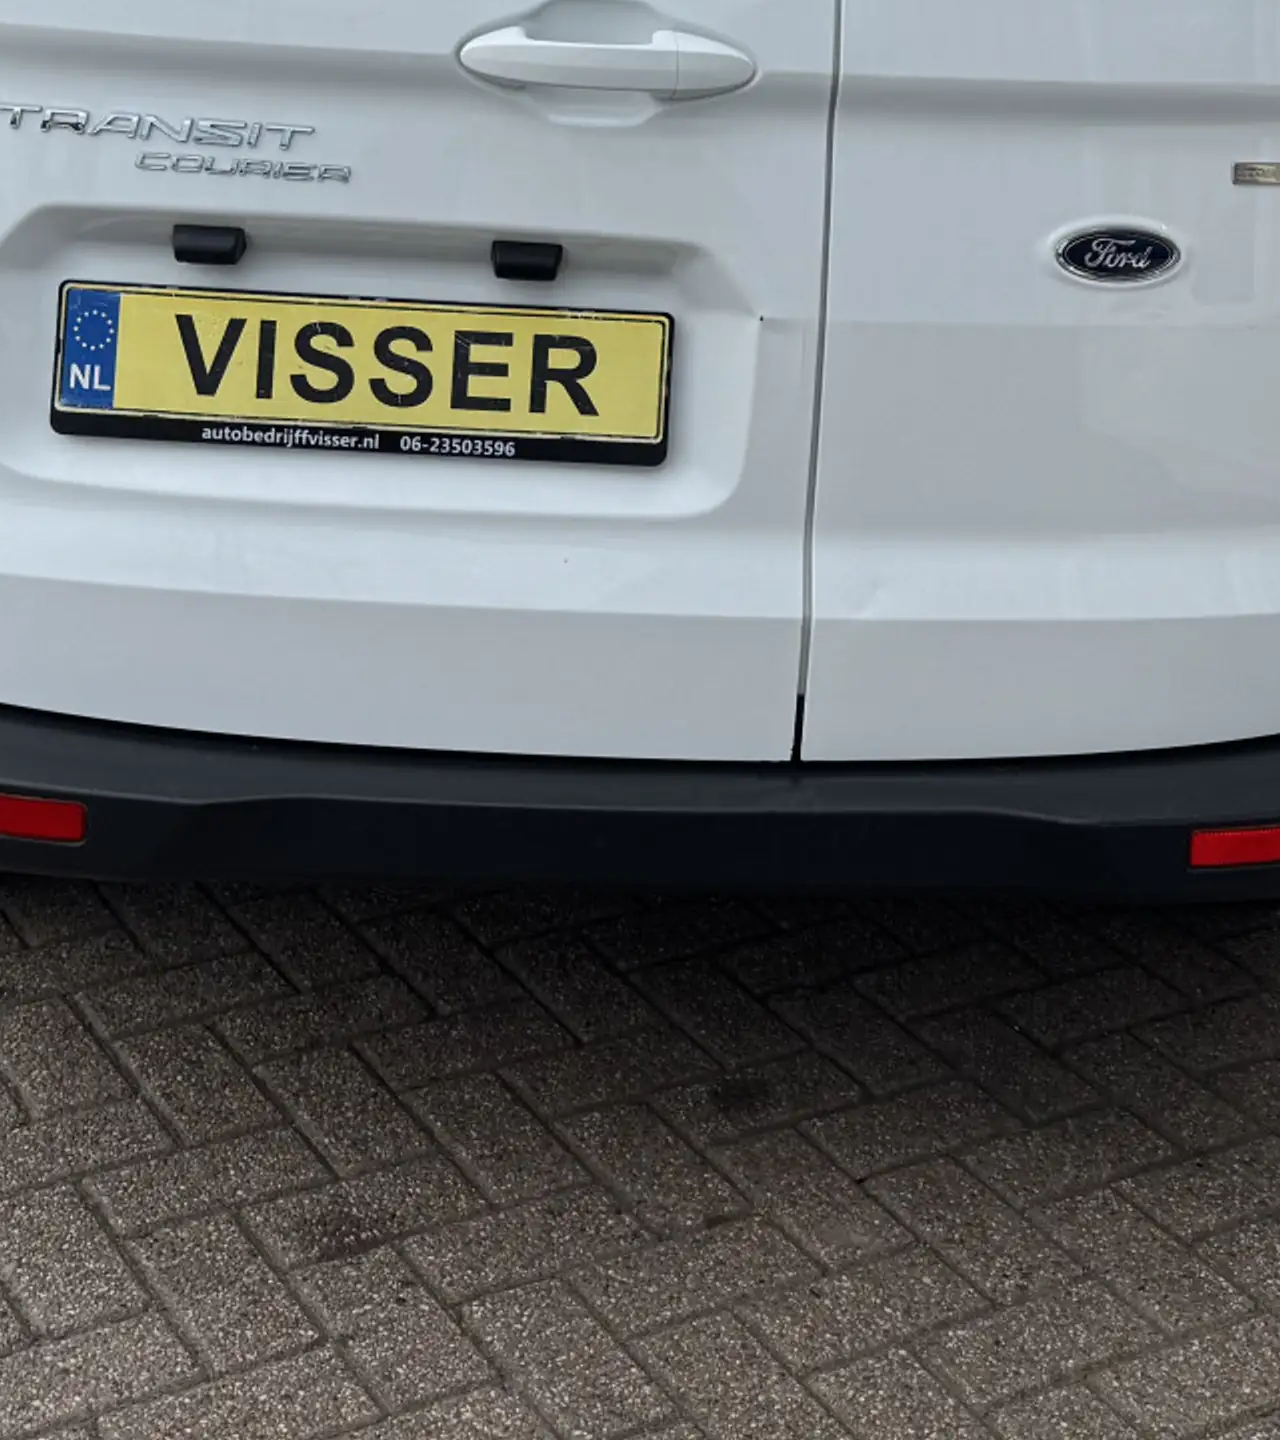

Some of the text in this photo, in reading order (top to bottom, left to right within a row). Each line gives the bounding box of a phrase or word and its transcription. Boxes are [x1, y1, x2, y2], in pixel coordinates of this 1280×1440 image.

[135, 151, 352, 184] COURIER
[1083, 237, 1154, 269] Ford
[69, 314, 600, 417] NL VISSER
[201, 425, 516, 457] autobedrijffvisser.nl 06-23503596
